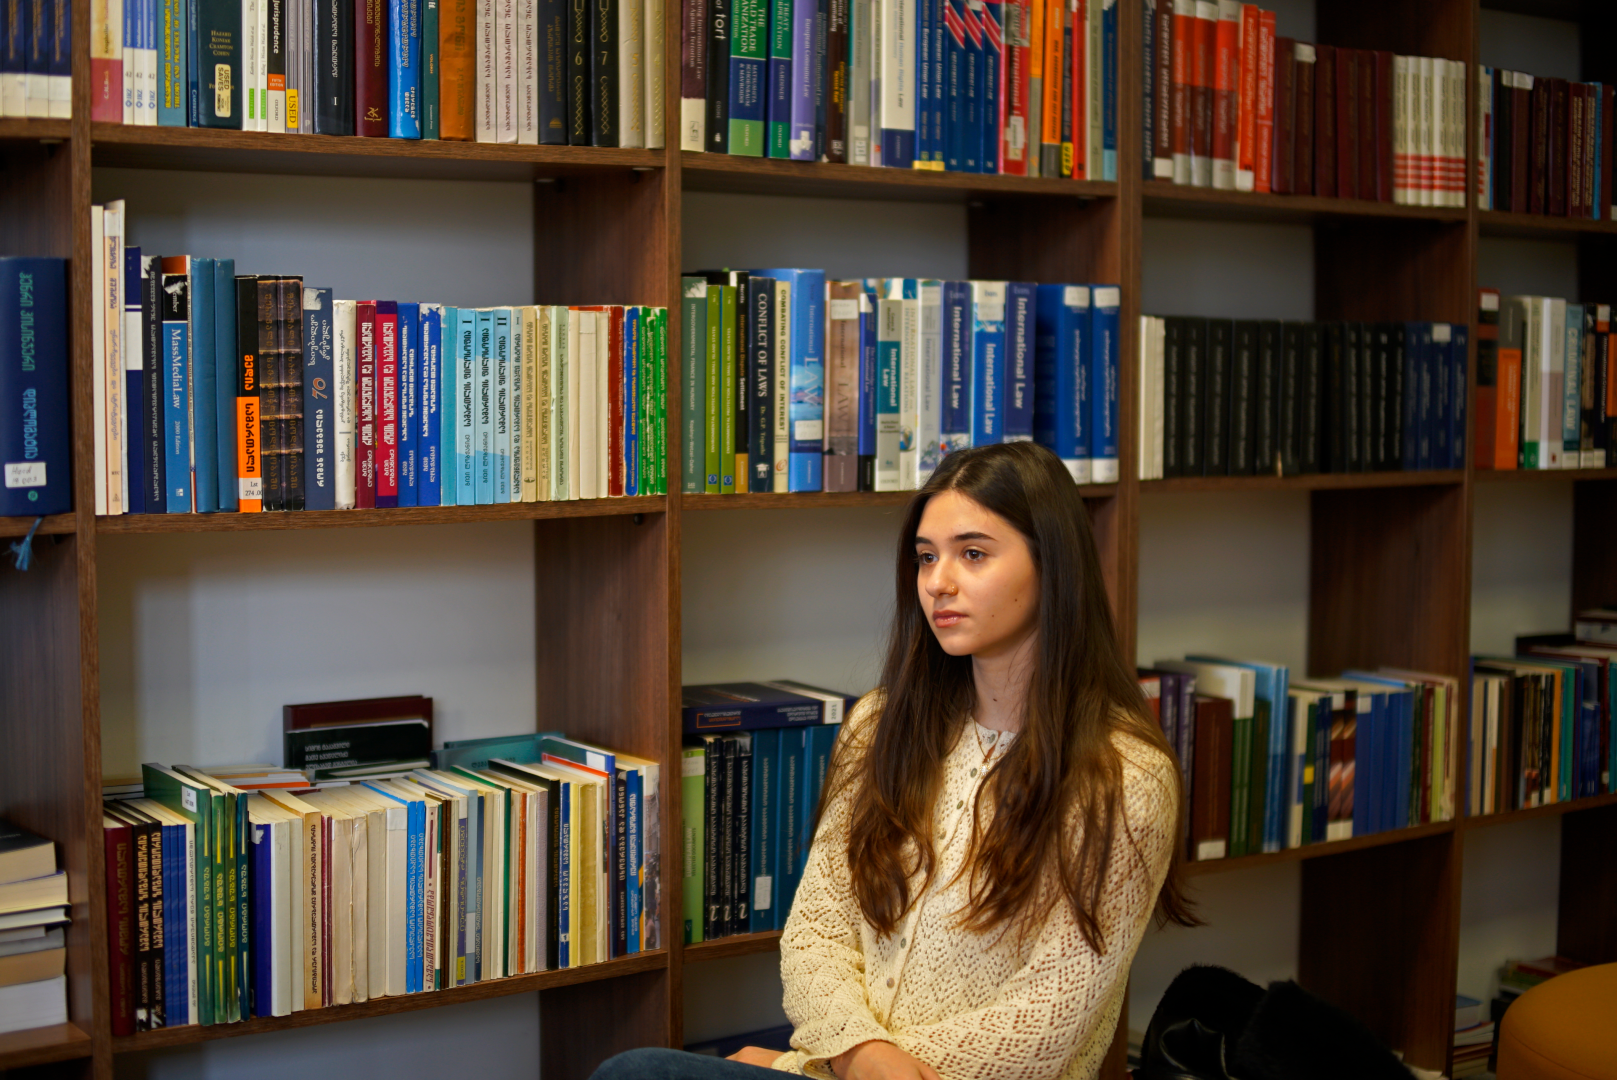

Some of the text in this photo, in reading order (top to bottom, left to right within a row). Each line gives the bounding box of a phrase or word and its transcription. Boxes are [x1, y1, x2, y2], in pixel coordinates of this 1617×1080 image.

[174, 20, 180, 28] OF
[715, 13, 727, 40] tort
[749, 20, 757, 51] TRADE
[575, 51, 582, 66] 6
[601, 51, 608, 65] 7
[631, 53, 639, 67] 5
[654, 53, 661, 67] 4
[804, 18, 812, 98] European Consumer Law
[1013, 37, 1022, 106] International
[19, 272, 34, 307] ჰენრი
[497, 317, 507, 326] II
[757, 293, 768, 346] CONFLICT
[20, 310, 35, 371] კისინჯერი
[308, 314, 319, 366] საიუბილეო
[319, 320, 331, 360] კრებული
[757, 350, 768, 364] OF
[953, 306, 962, 408] International Law
[1015, 297, 1028, 408] International Law
[171, 328, 182, 408] MassMediaLaw
[361, 322, 372, 445] რომის სახელმწიფო და სამართალი
[383, 322, 394, 445] რომის სახელმწიფო და სამართალი
[757, 368, 768, 397] LAWS
[779, 381, 786, 391] OF
[804, 357, 819, 406] LAW
[890, 348, 898, 407] International
[312, 378, 328, 400] 70
[837, 383, 849, 421] LAW
[985, 343, 996, 434] International Law
[23, 388, 38, 459] დიპლომატია
[244, 354, 256, 473] მედია სამართალი
[1566, 400, 1578, 430] LAW
[315, 409, 325, 487] რომან შენგელია
[514, 434, 520, 443] და
[831, 704, 840, 720] 2021
[619, 822, 626, 833] და
[629, 793, 637, 834] გეოგრაფია
[629, 834, 637, 876] იურიდიული
[116, 843, 129, 914] სამართალი
[202, 867, 211, 946] გიორგი ხუბუა
[240, 903, 248, 943] გიორგი
[118, 918, 129, 955] რომის
[228, 907, 236, 947] გიორგი
